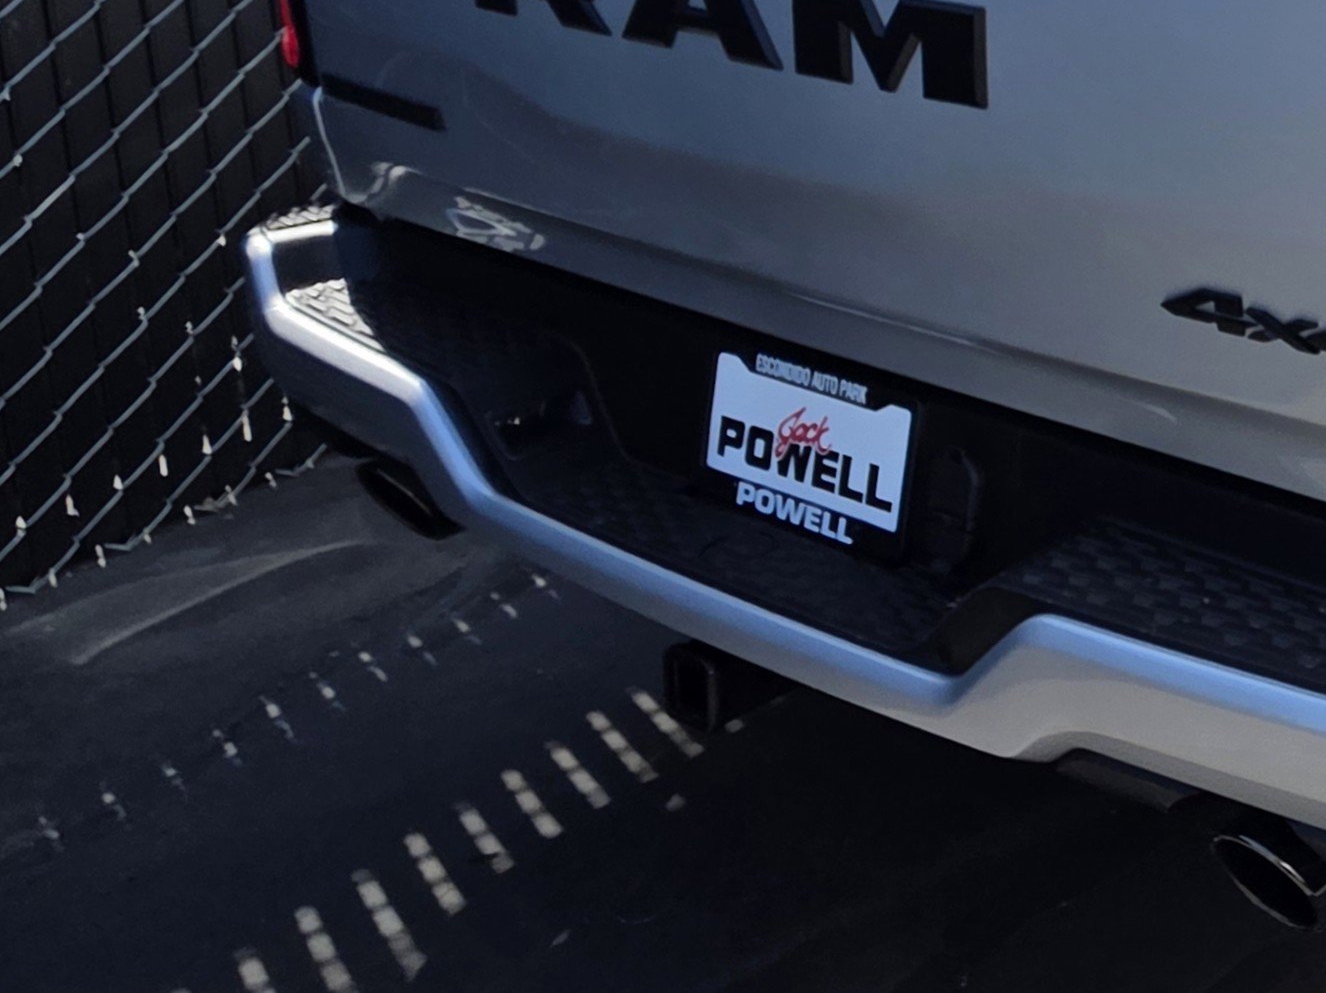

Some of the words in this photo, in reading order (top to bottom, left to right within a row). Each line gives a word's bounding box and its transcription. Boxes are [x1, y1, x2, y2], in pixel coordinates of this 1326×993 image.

[811, 371, 839, 395] AUTO
[839, 379, 868, 404] PARK
[775, 406, 832, 458] Jack
[717, 415, 893, 513] POWELL
[736, 481, 853, 545] POWELL
